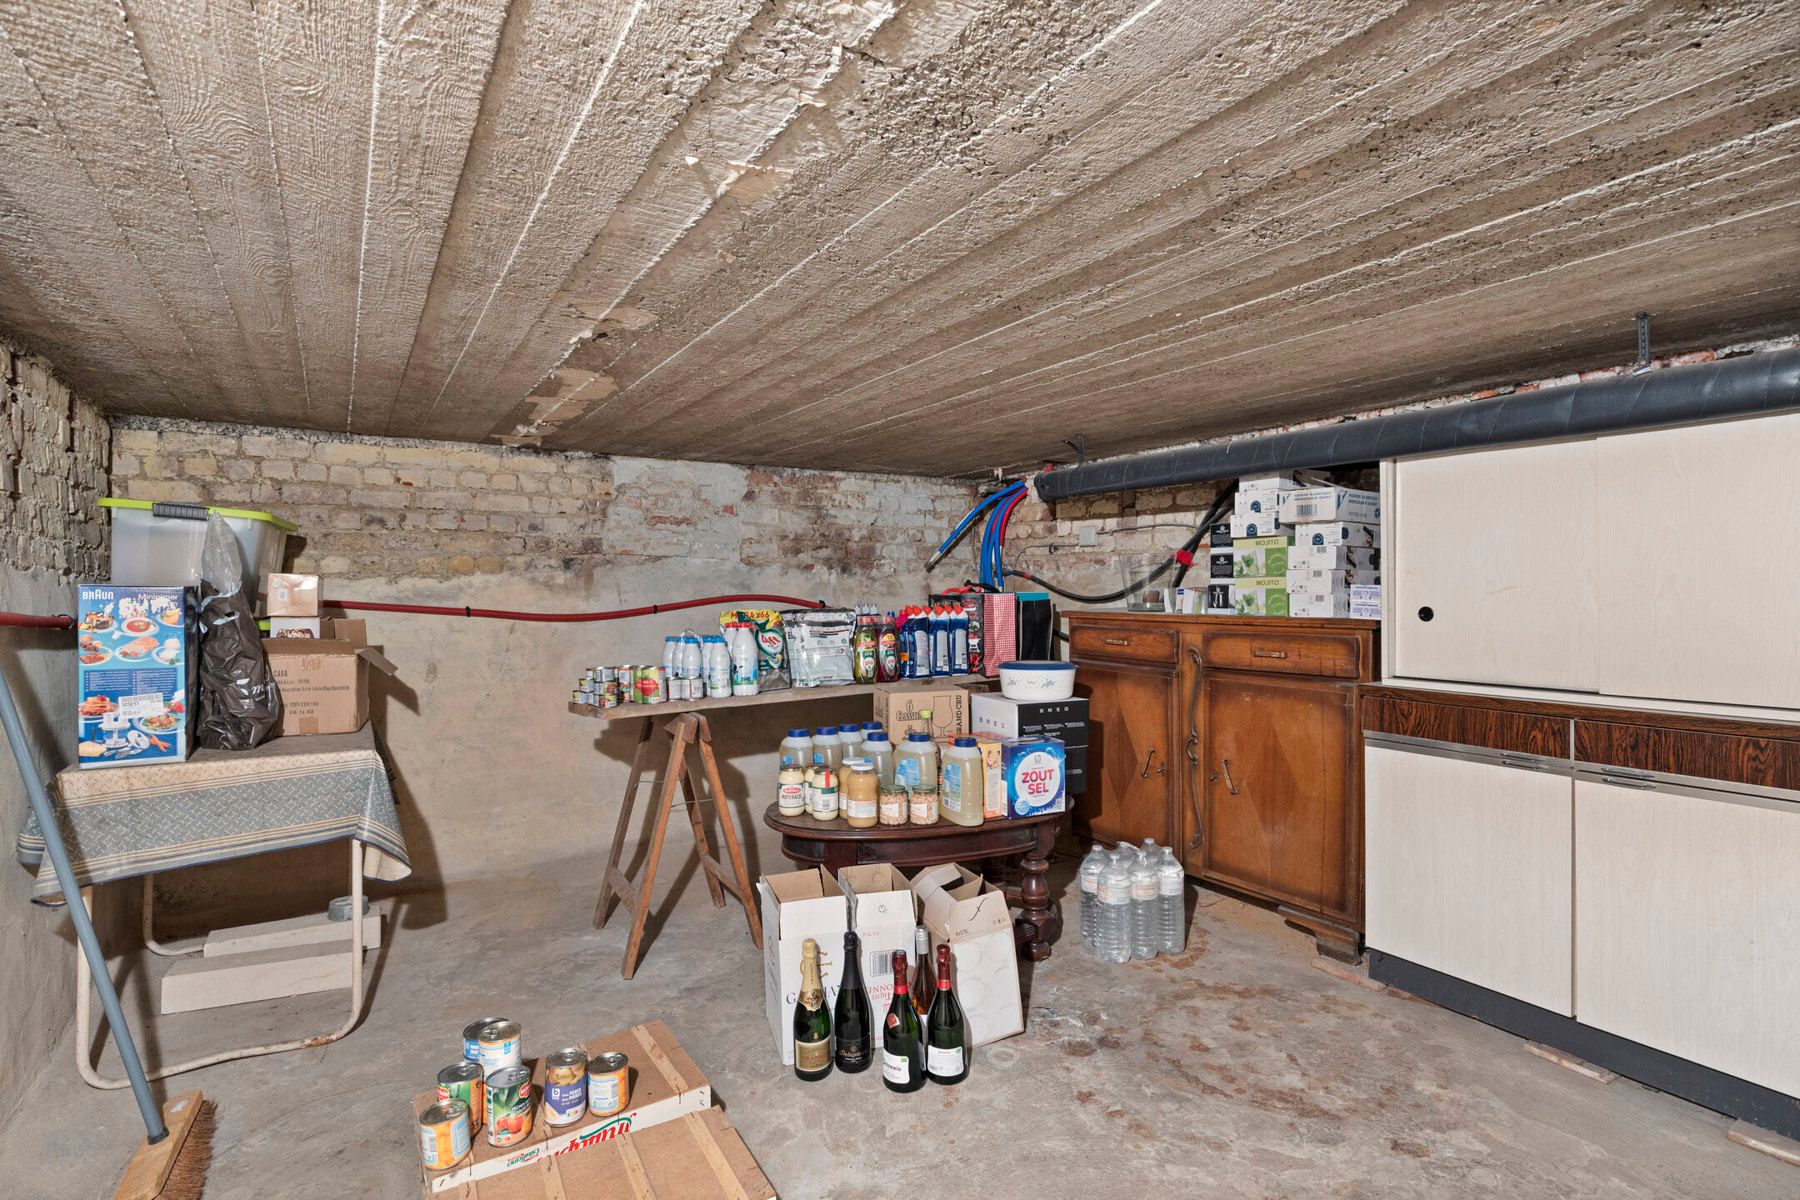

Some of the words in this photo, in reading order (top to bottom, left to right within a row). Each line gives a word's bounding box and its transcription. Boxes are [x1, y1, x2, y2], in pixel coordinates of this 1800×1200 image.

[82, 589, 114, 600] BRAUN
[906, 700, 914, 712] 6
[1040, 706, 1069, 714] SMEG
[1022, 769, 1054, 783] ZOUT
[1028, 782, 1049, 794] SEL
